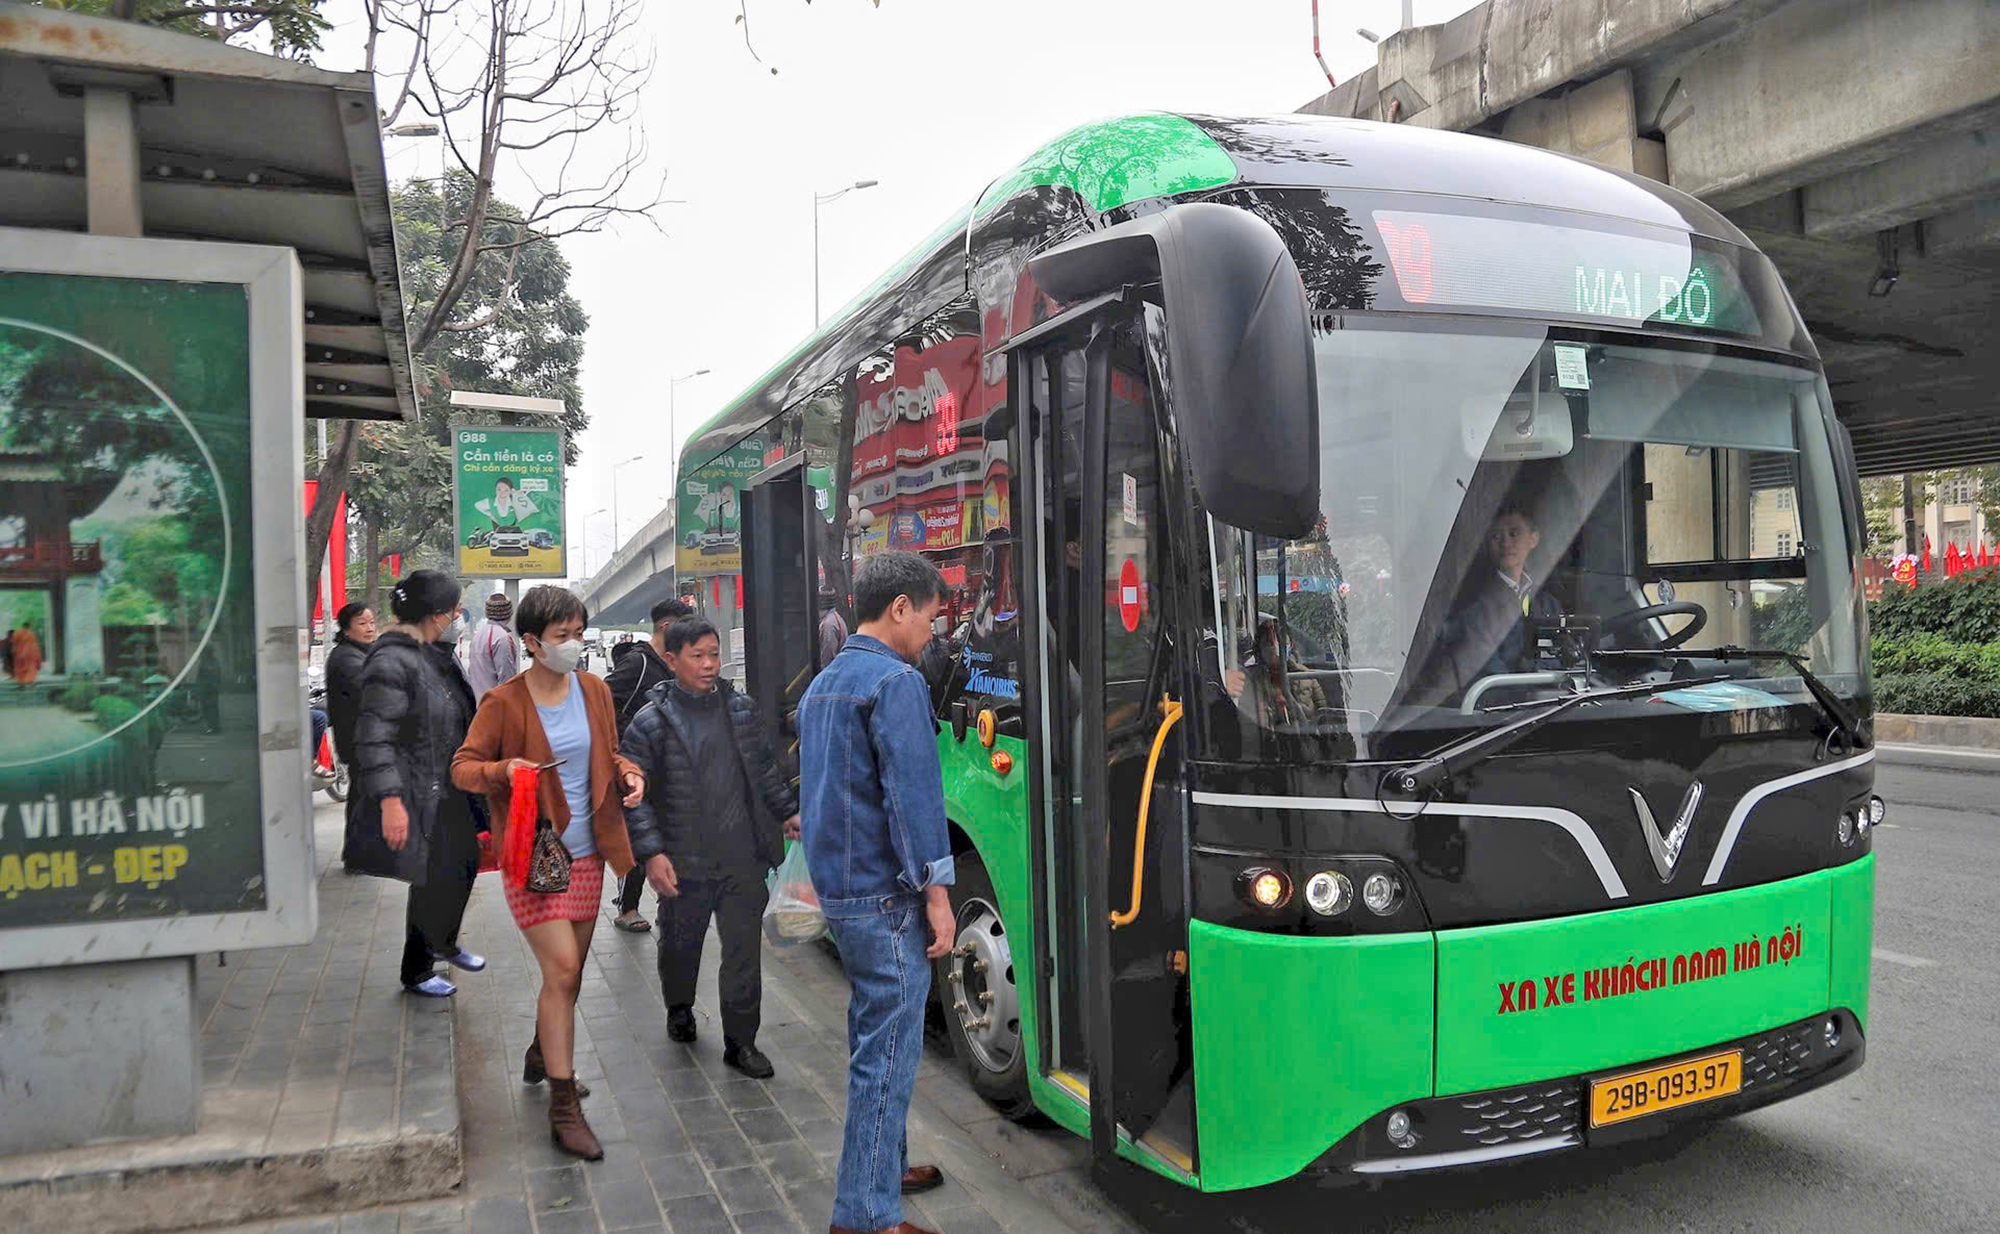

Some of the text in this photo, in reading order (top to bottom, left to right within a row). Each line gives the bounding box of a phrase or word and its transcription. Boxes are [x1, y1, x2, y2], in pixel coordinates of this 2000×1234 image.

[1575, 265, 1712, 325] MAI ĐÔ
[463, 448, 554, 462] Cần tiền là có
[529, 464, 540, 474] ký
[542, 465, 554, 473] xe
[965, 667, 1018, 698] HANOIBUS
[19, 793, 59, 839] VÌ
[71, 790, 127, 836] HÀ
[136, 788, 205, 838] NỘI
[113, 843, 190, 890] ĐẸP
[1543, 973, 1575, 1008] XE
[1583, 956, 1667, 1001] KHÁCH
[1733, 933, 1761, 972] HÀ
[1606, 1062, 1729, 1115] 29B-093.97
